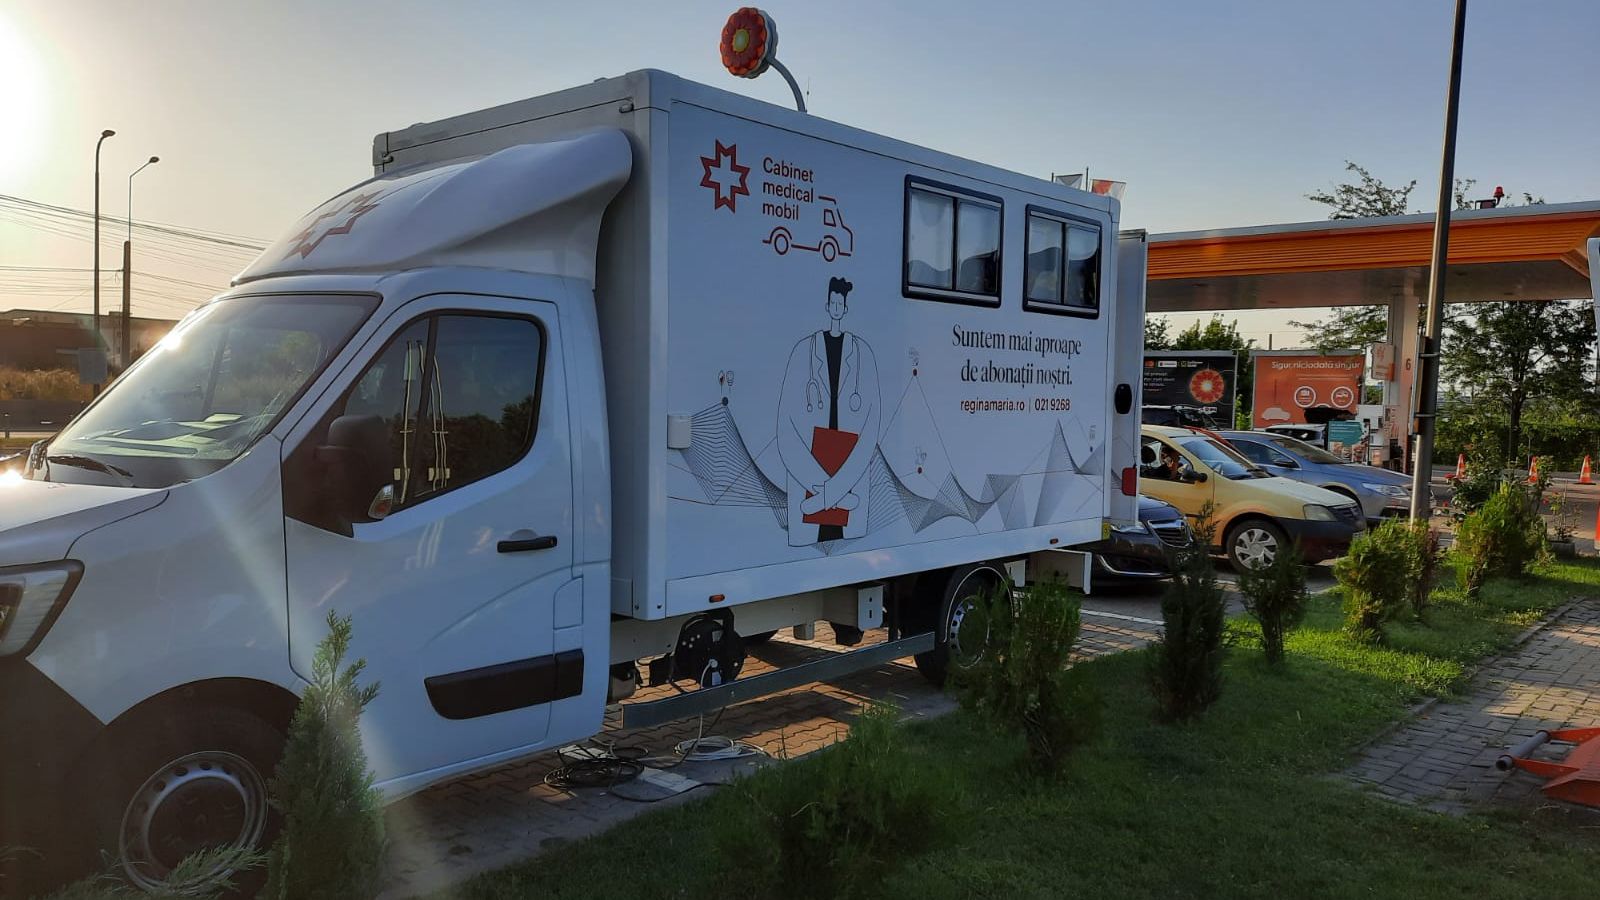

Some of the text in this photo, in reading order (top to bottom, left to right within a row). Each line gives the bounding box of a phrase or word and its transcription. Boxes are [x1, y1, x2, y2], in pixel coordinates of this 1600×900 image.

[763, 157, 814, 183] Cabinet
[762, 181, 814, 203] medical
[762, 202, 799, 220] mobil
[952, 324, 1082, 360] Suntem mai aproape
[960, 359, 1073, 389] de abonații noștri.
[1405, 358, 1412, 371] 6
[960, 397, 1025, 414] reginamaria.ro
